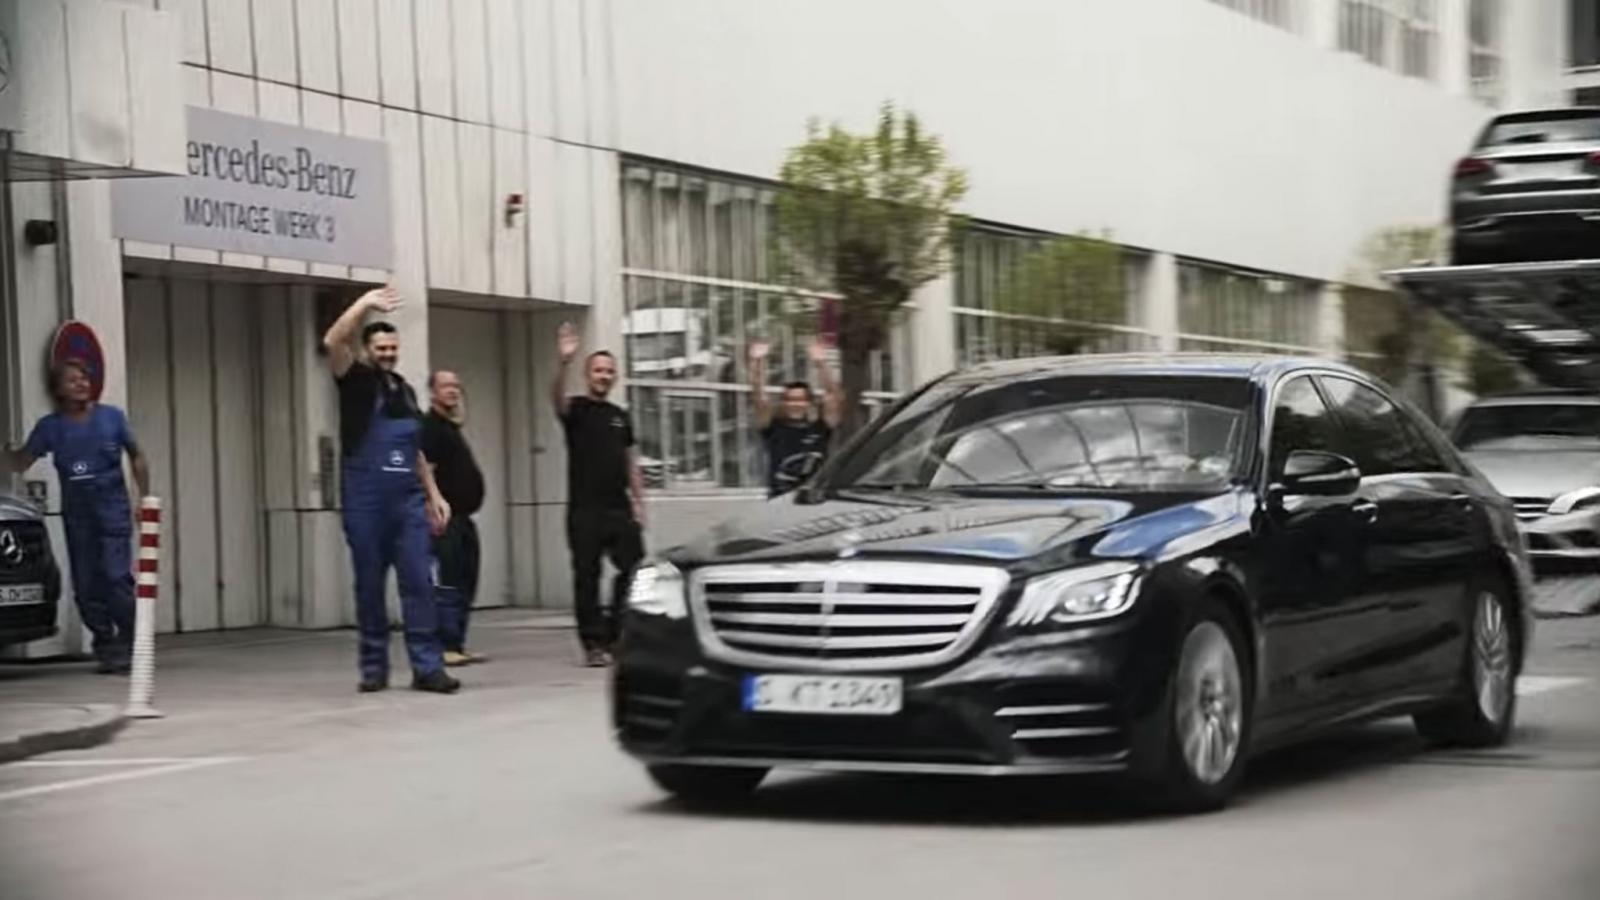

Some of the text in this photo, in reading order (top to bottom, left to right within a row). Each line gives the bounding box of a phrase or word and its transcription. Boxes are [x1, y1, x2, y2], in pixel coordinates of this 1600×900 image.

[187, 140, 357, 199] ercedes-Benz
[184, 196, 336, 242] MONTAGE WERK 3
